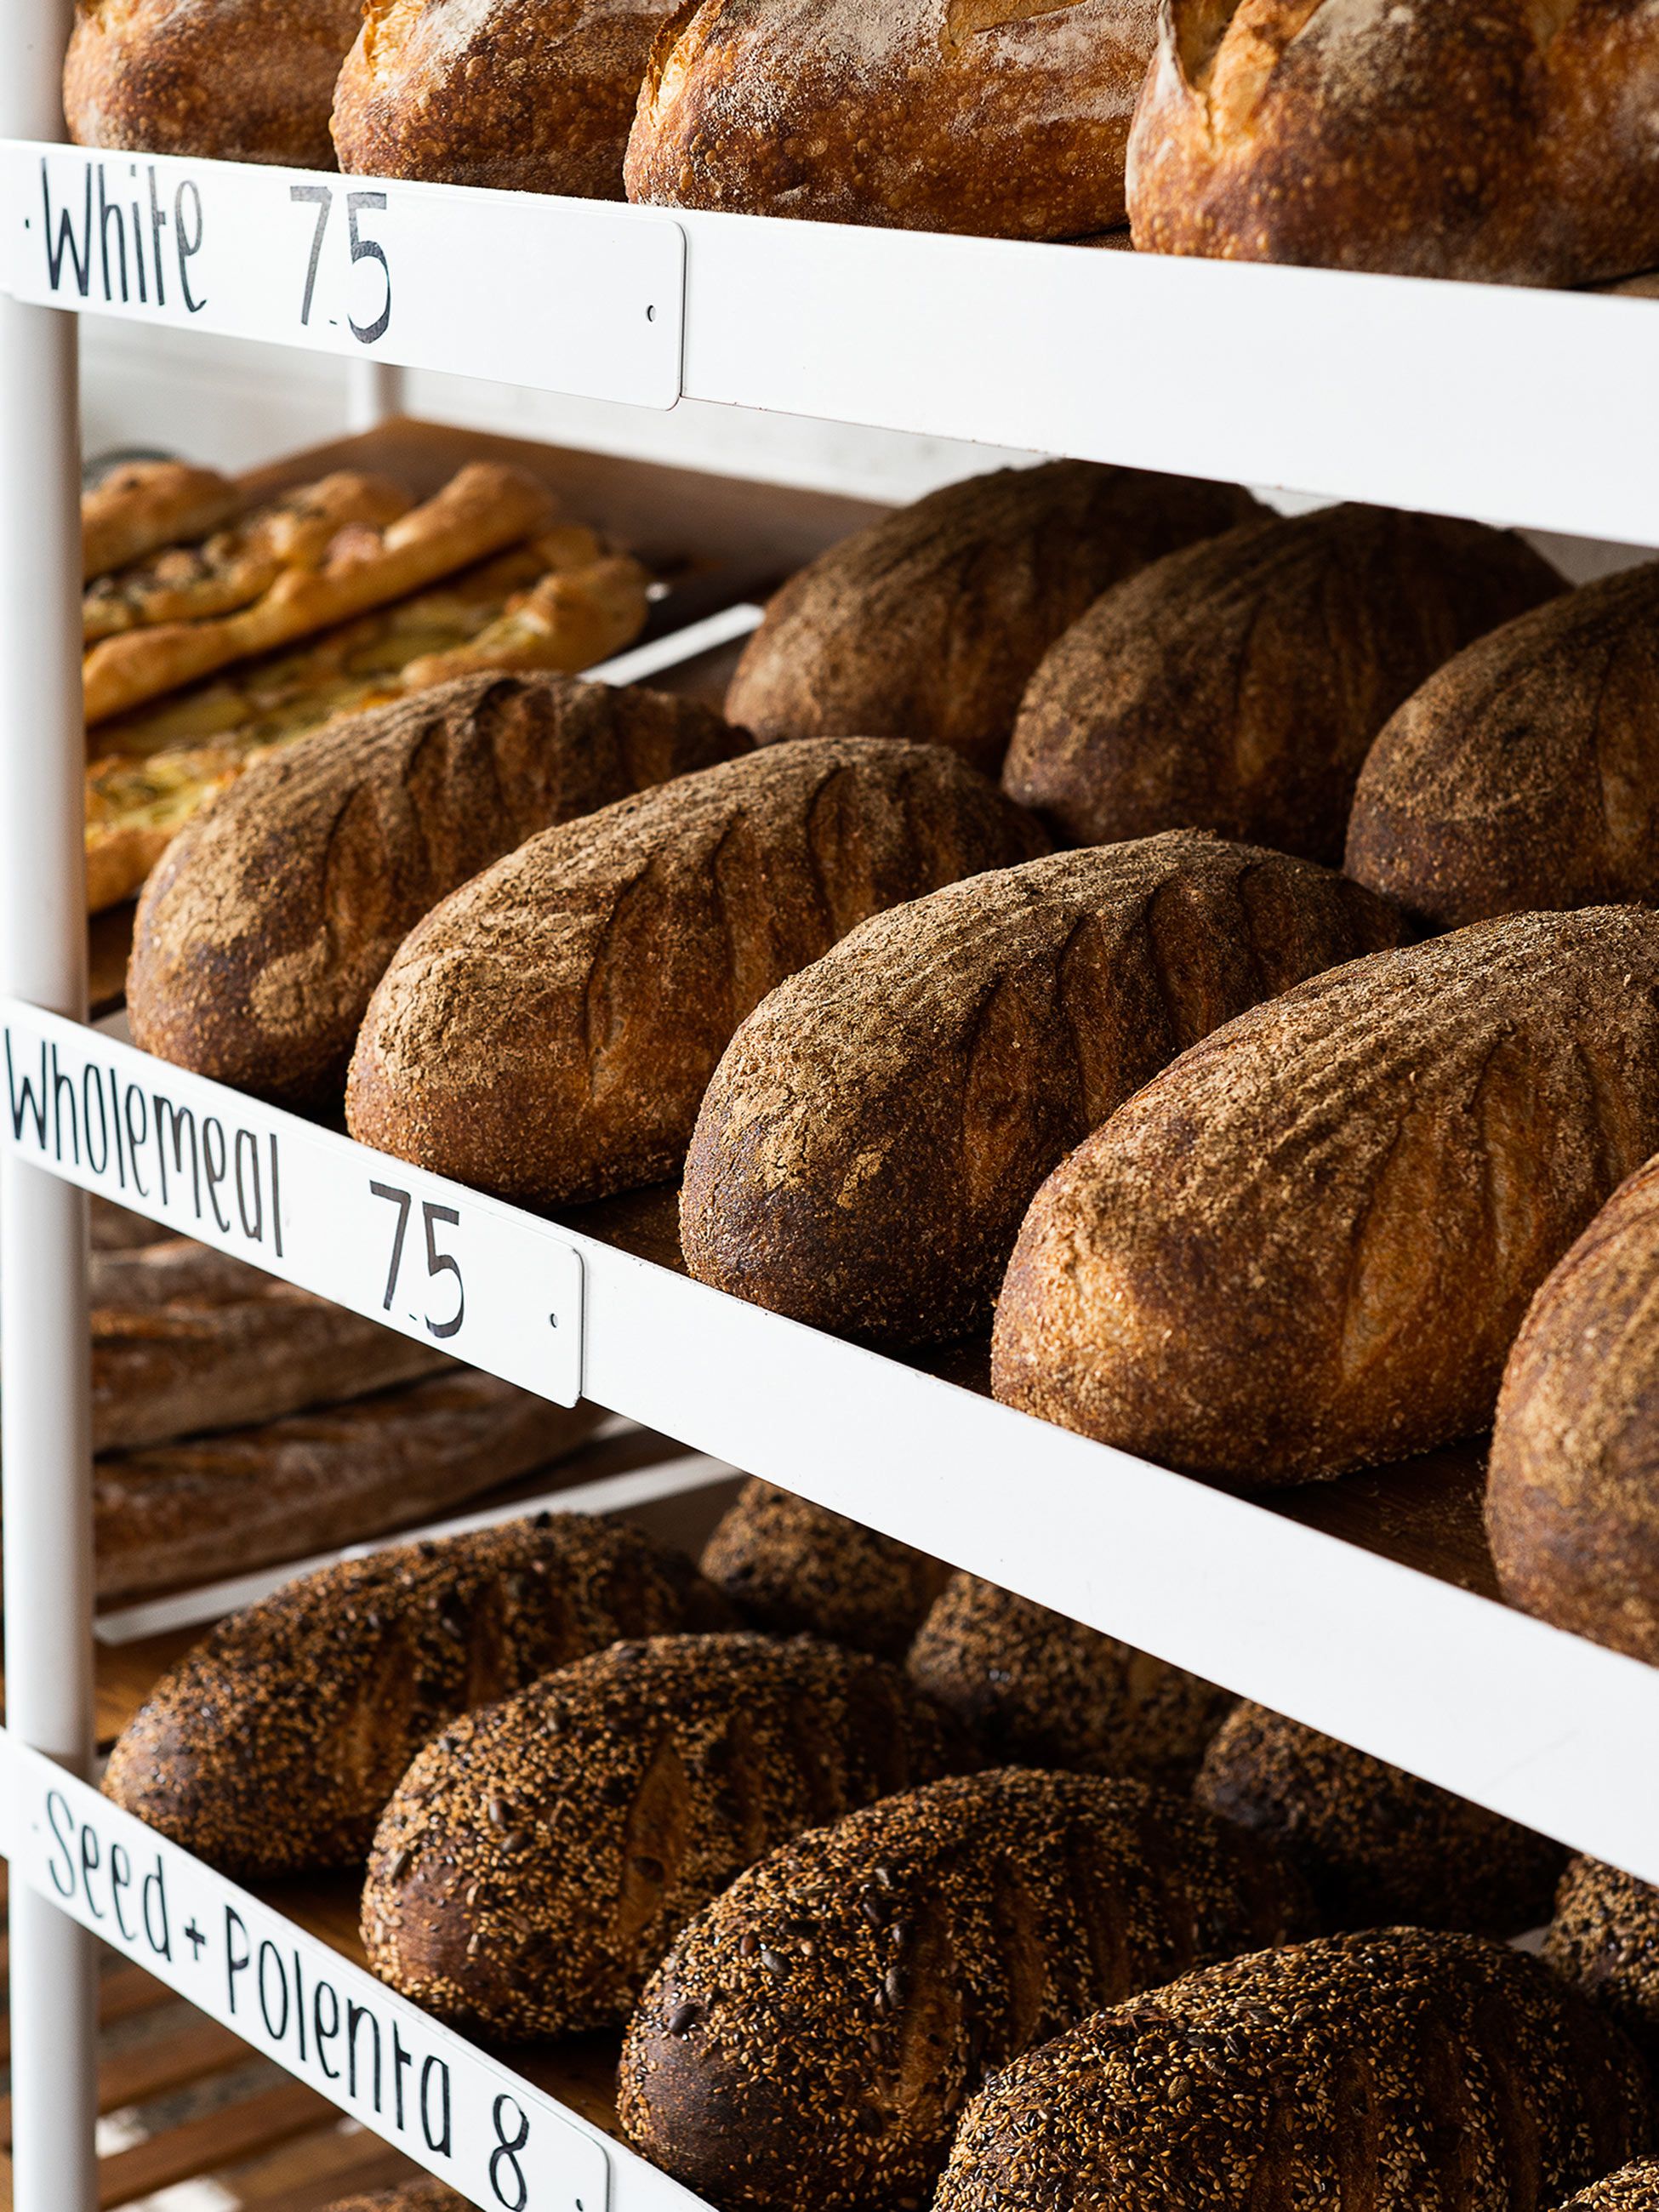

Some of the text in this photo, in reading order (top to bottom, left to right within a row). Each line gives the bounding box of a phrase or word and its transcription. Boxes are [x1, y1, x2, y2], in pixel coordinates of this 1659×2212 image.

[40, 157, 208, 314] White
[4, 1028, 284, 1257] Wholemeal
[46, 1790, 173, 1964] Seed
[225, 1904, 452, 2159] Polenta
[488, 2094, 531, 2212] 8
